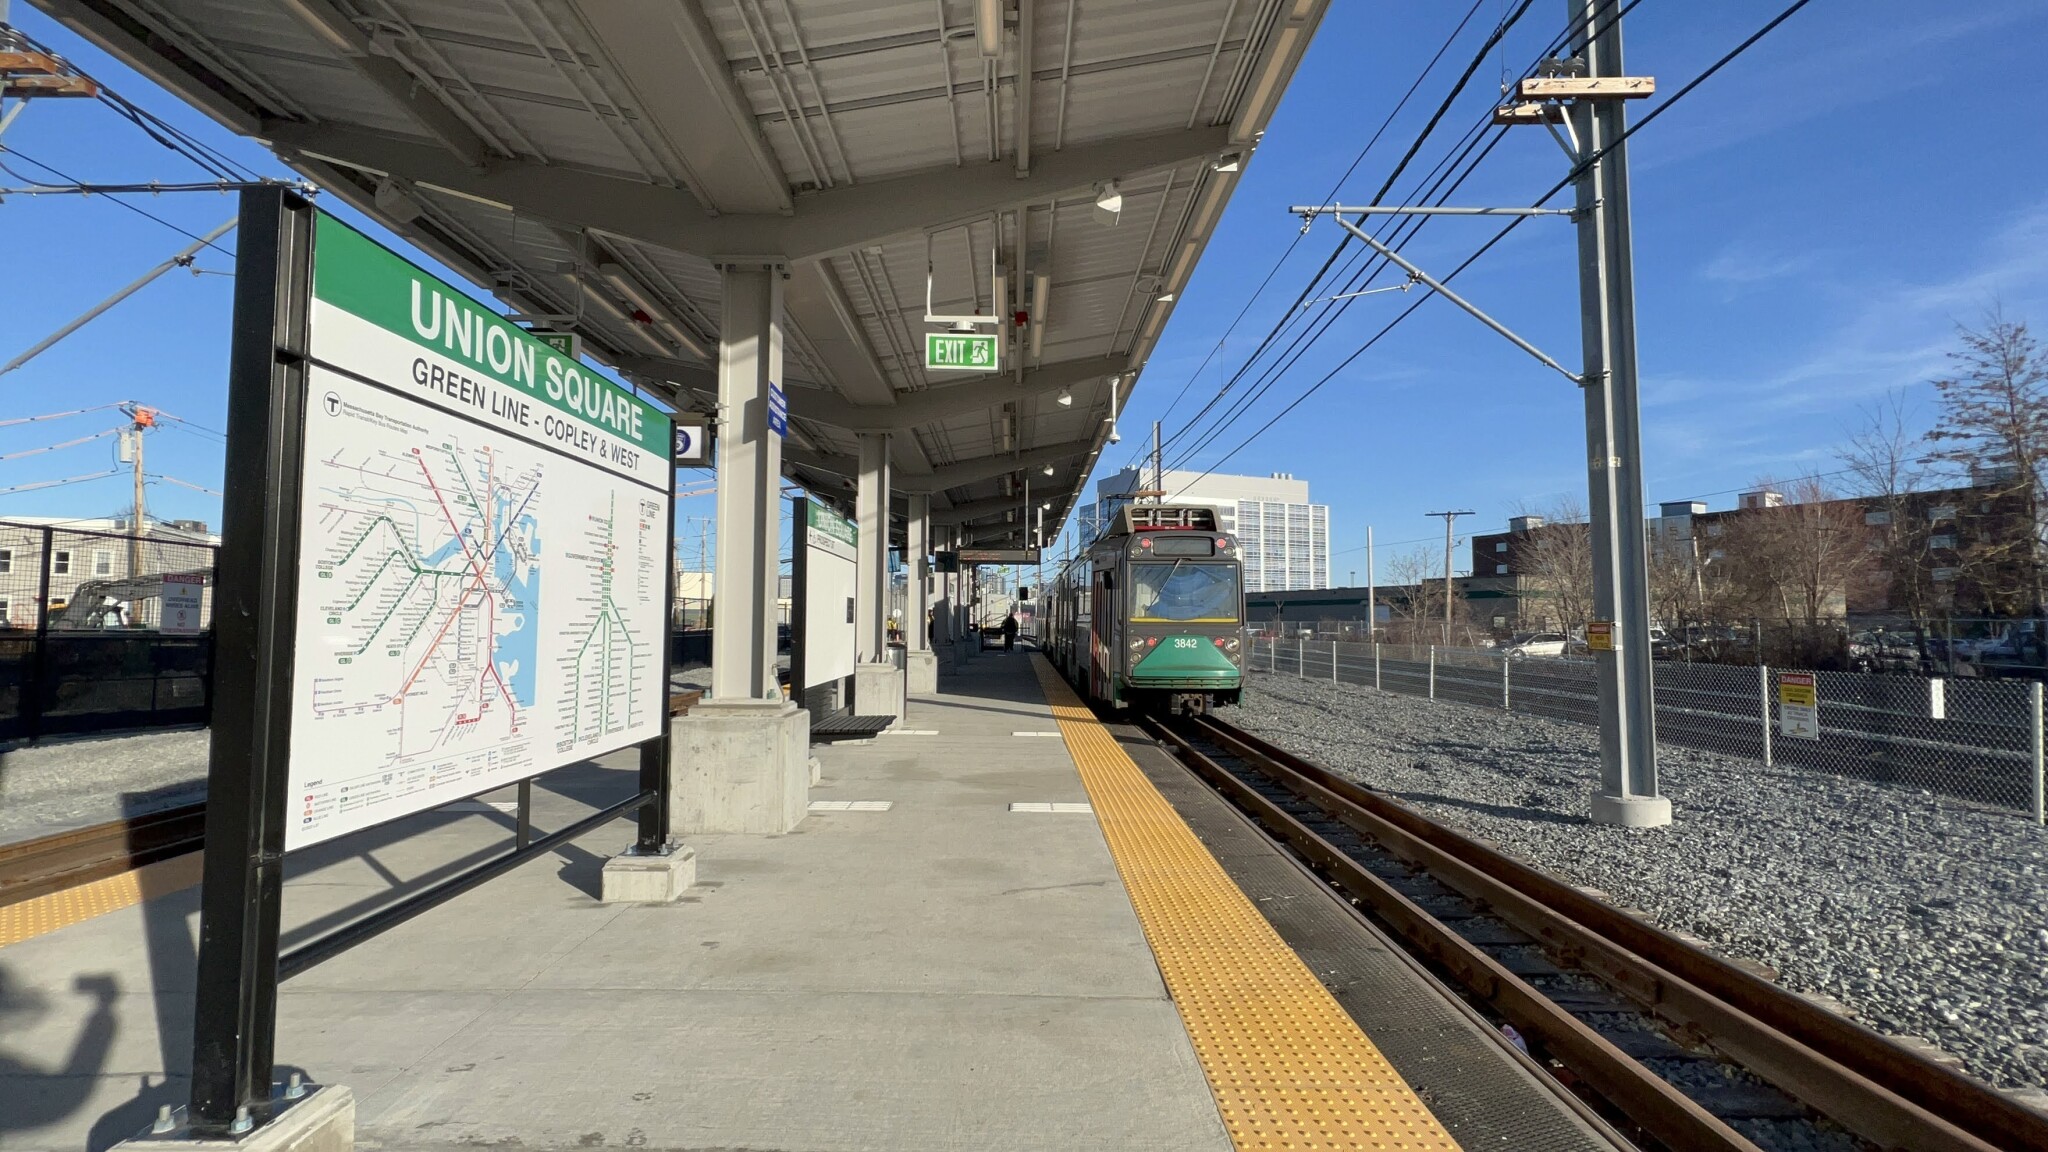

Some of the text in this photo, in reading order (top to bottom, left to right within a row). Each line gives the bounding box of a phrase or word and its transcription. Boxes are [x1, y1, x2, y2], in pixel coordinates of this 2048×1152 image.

[935, 339, 966, 364] EXIT
[411, 278, 644, 442] UNION SQUARE
[412, 357, 487, 411] GREEN
[491, 390, 530, 429] LINE
[544, 414, 598, 456] COPLEY
[600, 443, 608, 460] &
[611, 445, 641, 472] WEST
[167, 575, 202, 584] DANGER
[1174, 638, 1197, 649] 3842
[1781, 676, 1812, 685] DANGER
[304, 779, 323, 788] Legend
